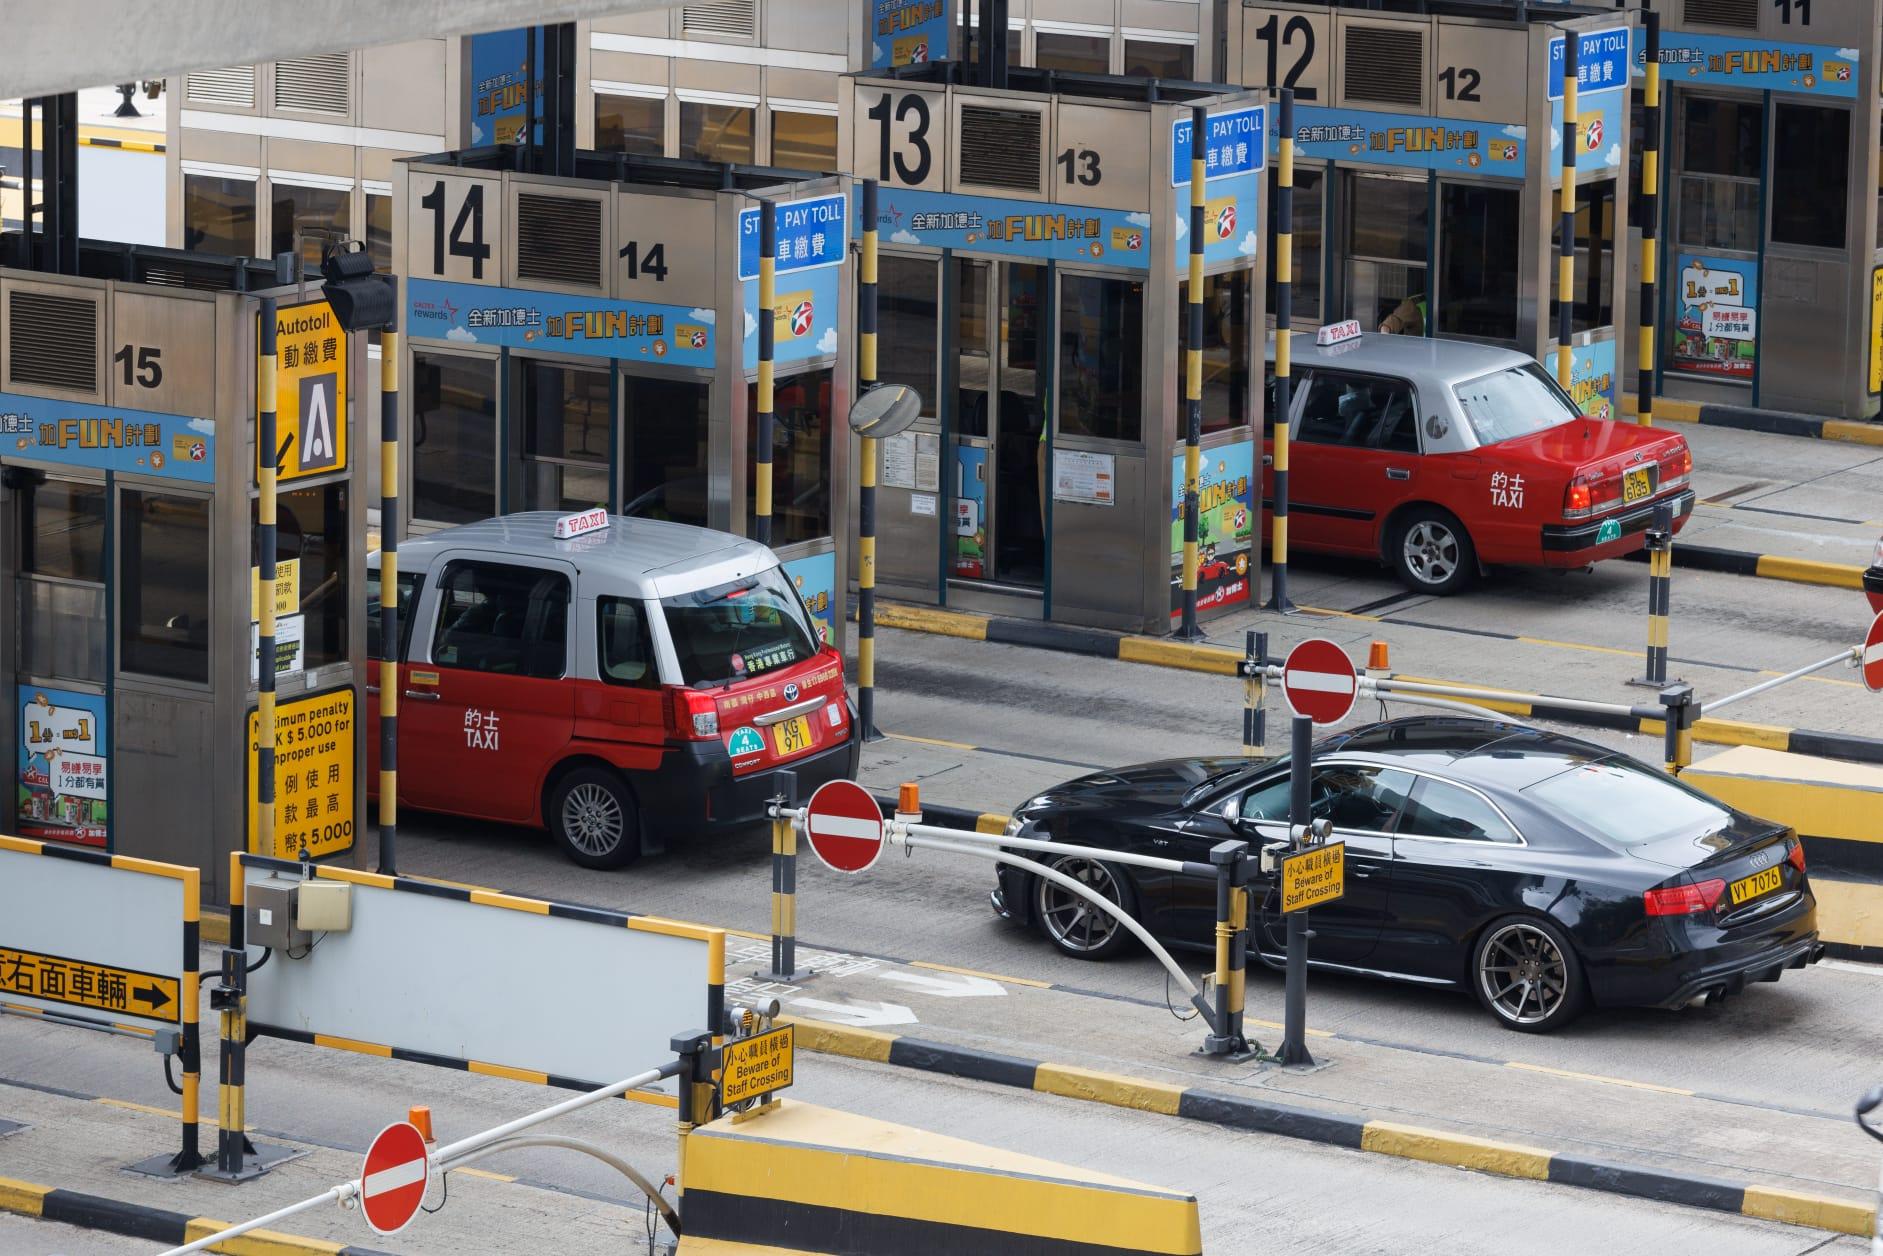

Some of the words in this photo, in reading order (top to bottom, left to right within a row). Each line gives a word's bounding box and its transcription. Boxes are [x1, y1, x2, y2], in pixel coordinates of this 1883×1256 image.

[1775, 0, 1811, 26] 11
[1256, 15, 1318, 101] 12
[1553, 44, 1580, 61] ST,
[1583, 38, 1601, 56] PAY
[1603, 34, 1626, 52] TOLL
[1438, 67, 1481, 102] 12
[1578, 60, 1614, 84] 車繳費
[868, 93, 932, 186] 13
[1178, 127, 1209, 144] ST,
[1213, 119, 1234, 138] PAY
[1236, 114, 1261, 134] TOLL
[1057, 148, 1102, 187] 13
[1207, 142, 1248, 170] 車繳費
[421, 180, 491, 280] 14
[744, 216, 780, 235] ST,
[785, 208, 809, 228] PAY
[811, 203, 841, 223] TOLL
[911, 210, 983, 231] 全新加德士
[777, 232, 826, 262] 車繳費
[619, 240, 668, 282] 14
[276, 312, 331, 337] Autotoll
[414, 309, 448, 320] rewards
[467, 306, 541, 328] 全新加德士
[1330, 321, 1358, 340] TAXI
[278, 337, 337, 370] 動繳費
[115, 344, 163, 389] 15
[1491, 471, 1525, 492] 的士
[1629, 471, 1642, 486] SL
[1490, 488, 1523, 509] TAXI
[568, 511, 605, 533] TAXI
[309, 702, 349, 723] penalty
[465, 708, 500, 730] 的士
[287, 730, 294, 745] $
[335, 719, 350, 733] for
[463, 728, 499, 751] TAXI
[741, 734, 749, 746] 4
[783, 719, 799, 737] KG
[274, 746, 315, 767] mproper
[318, 741, 336, 754] use
[735, 743, 758, 754] SEATS
[785, 733, 804, 752] 971
[284, 763, 340, 795] 例使用
[284, 792, 340, 825] 款最高
[1294, 872, 1323, 890] Beware
[1325, 867, 1333, 880] of
[1733, 880, 1748, 901] VY
[1751, 869, 1778, 894] 7076
[1286, 890, 1305, 907] Staff
[1305, 882, 1341, 900] Crossing
[736, 1060, 769, 1079] Beware
[771, 1054, 781, 1067] of
[727, 1078, 748, 1098] Staff
[750, 1068, 789, 1090] Crossing
